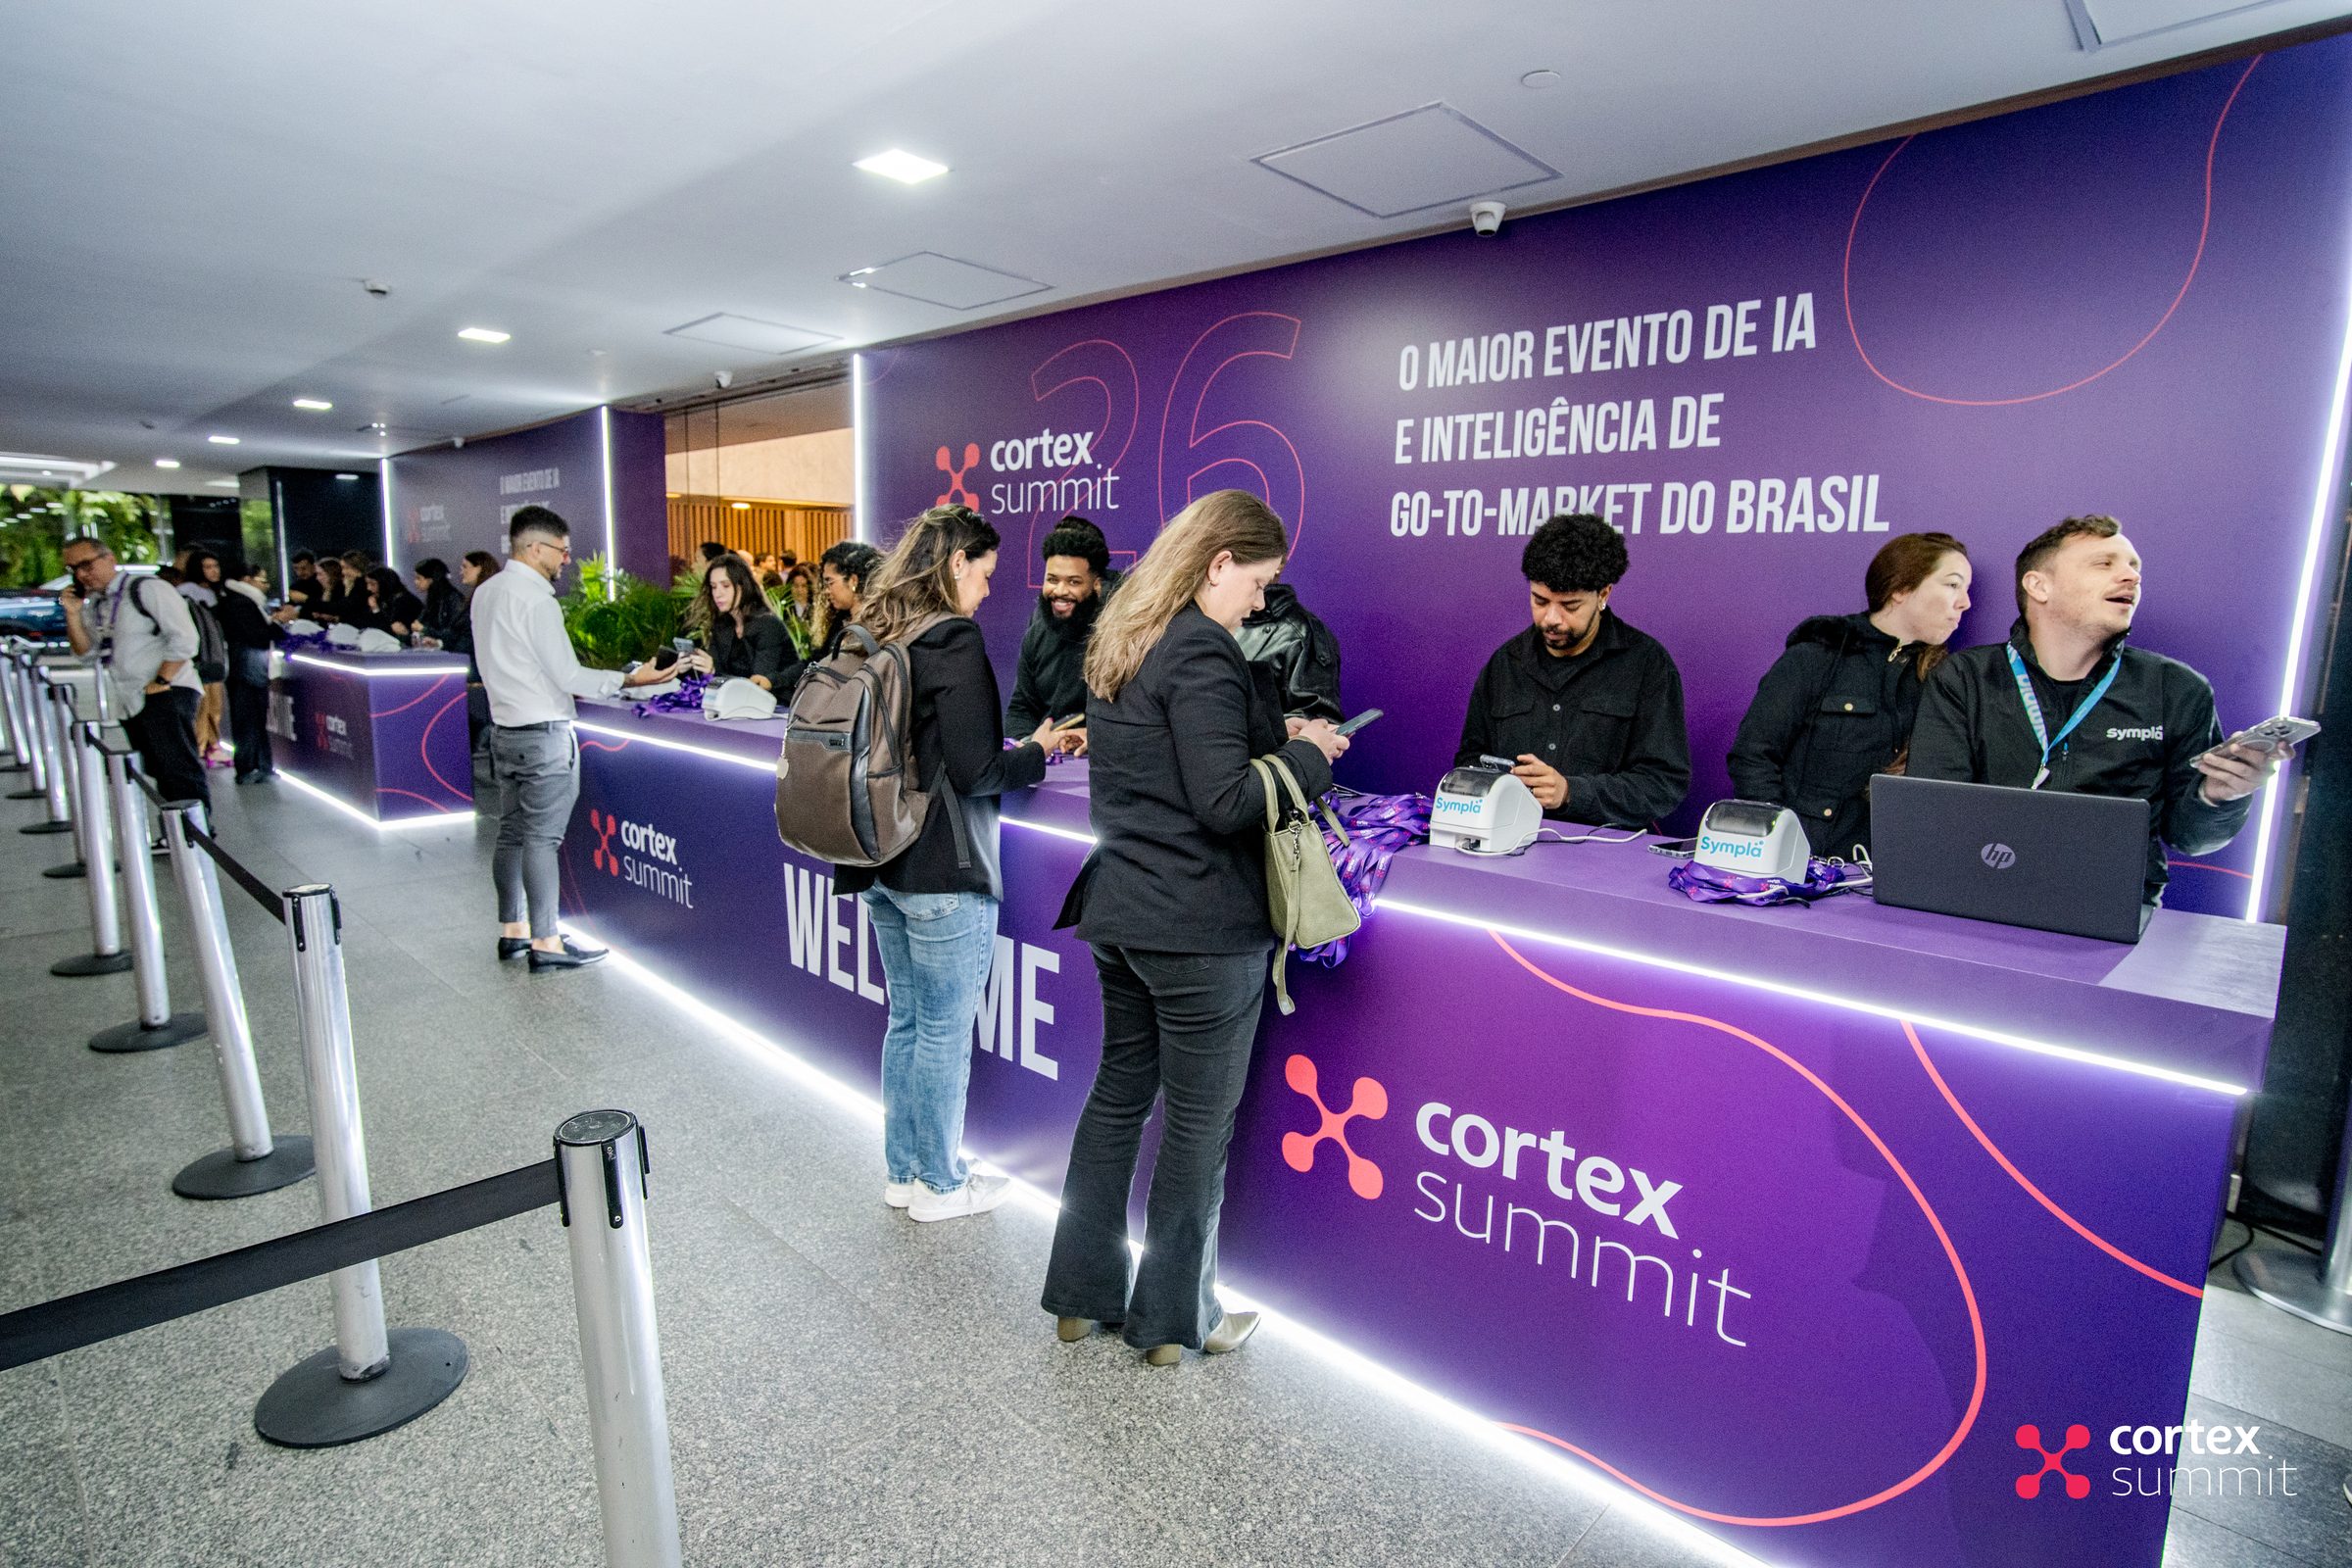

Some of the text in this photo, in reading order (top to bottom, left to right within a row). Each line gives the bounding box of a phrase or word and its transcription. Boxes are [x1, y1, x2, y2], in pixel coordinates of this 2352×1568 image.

[1398, 292, 1816, 391] O MAIOR EVENTO DE IA
[991, 428, 1093, 471] cortex
[1395, 393, 1725, 464] E INTELIGÊNCIA DE
[991, 464, 1119, 514] summit
[1660, 480, 1715, 534] DO
[1726, 474, 1889, 533] BRASIL
[621, 820, 676, 865] cortex
[1985, 843, 2012, 868] hp
[623, 852, 693, 909] summit
[784, 862, 1059, 1080] WELME
[1415, 1102, 1684, 1240] cortex
[1414, 1170, 1751, 1347] summit
